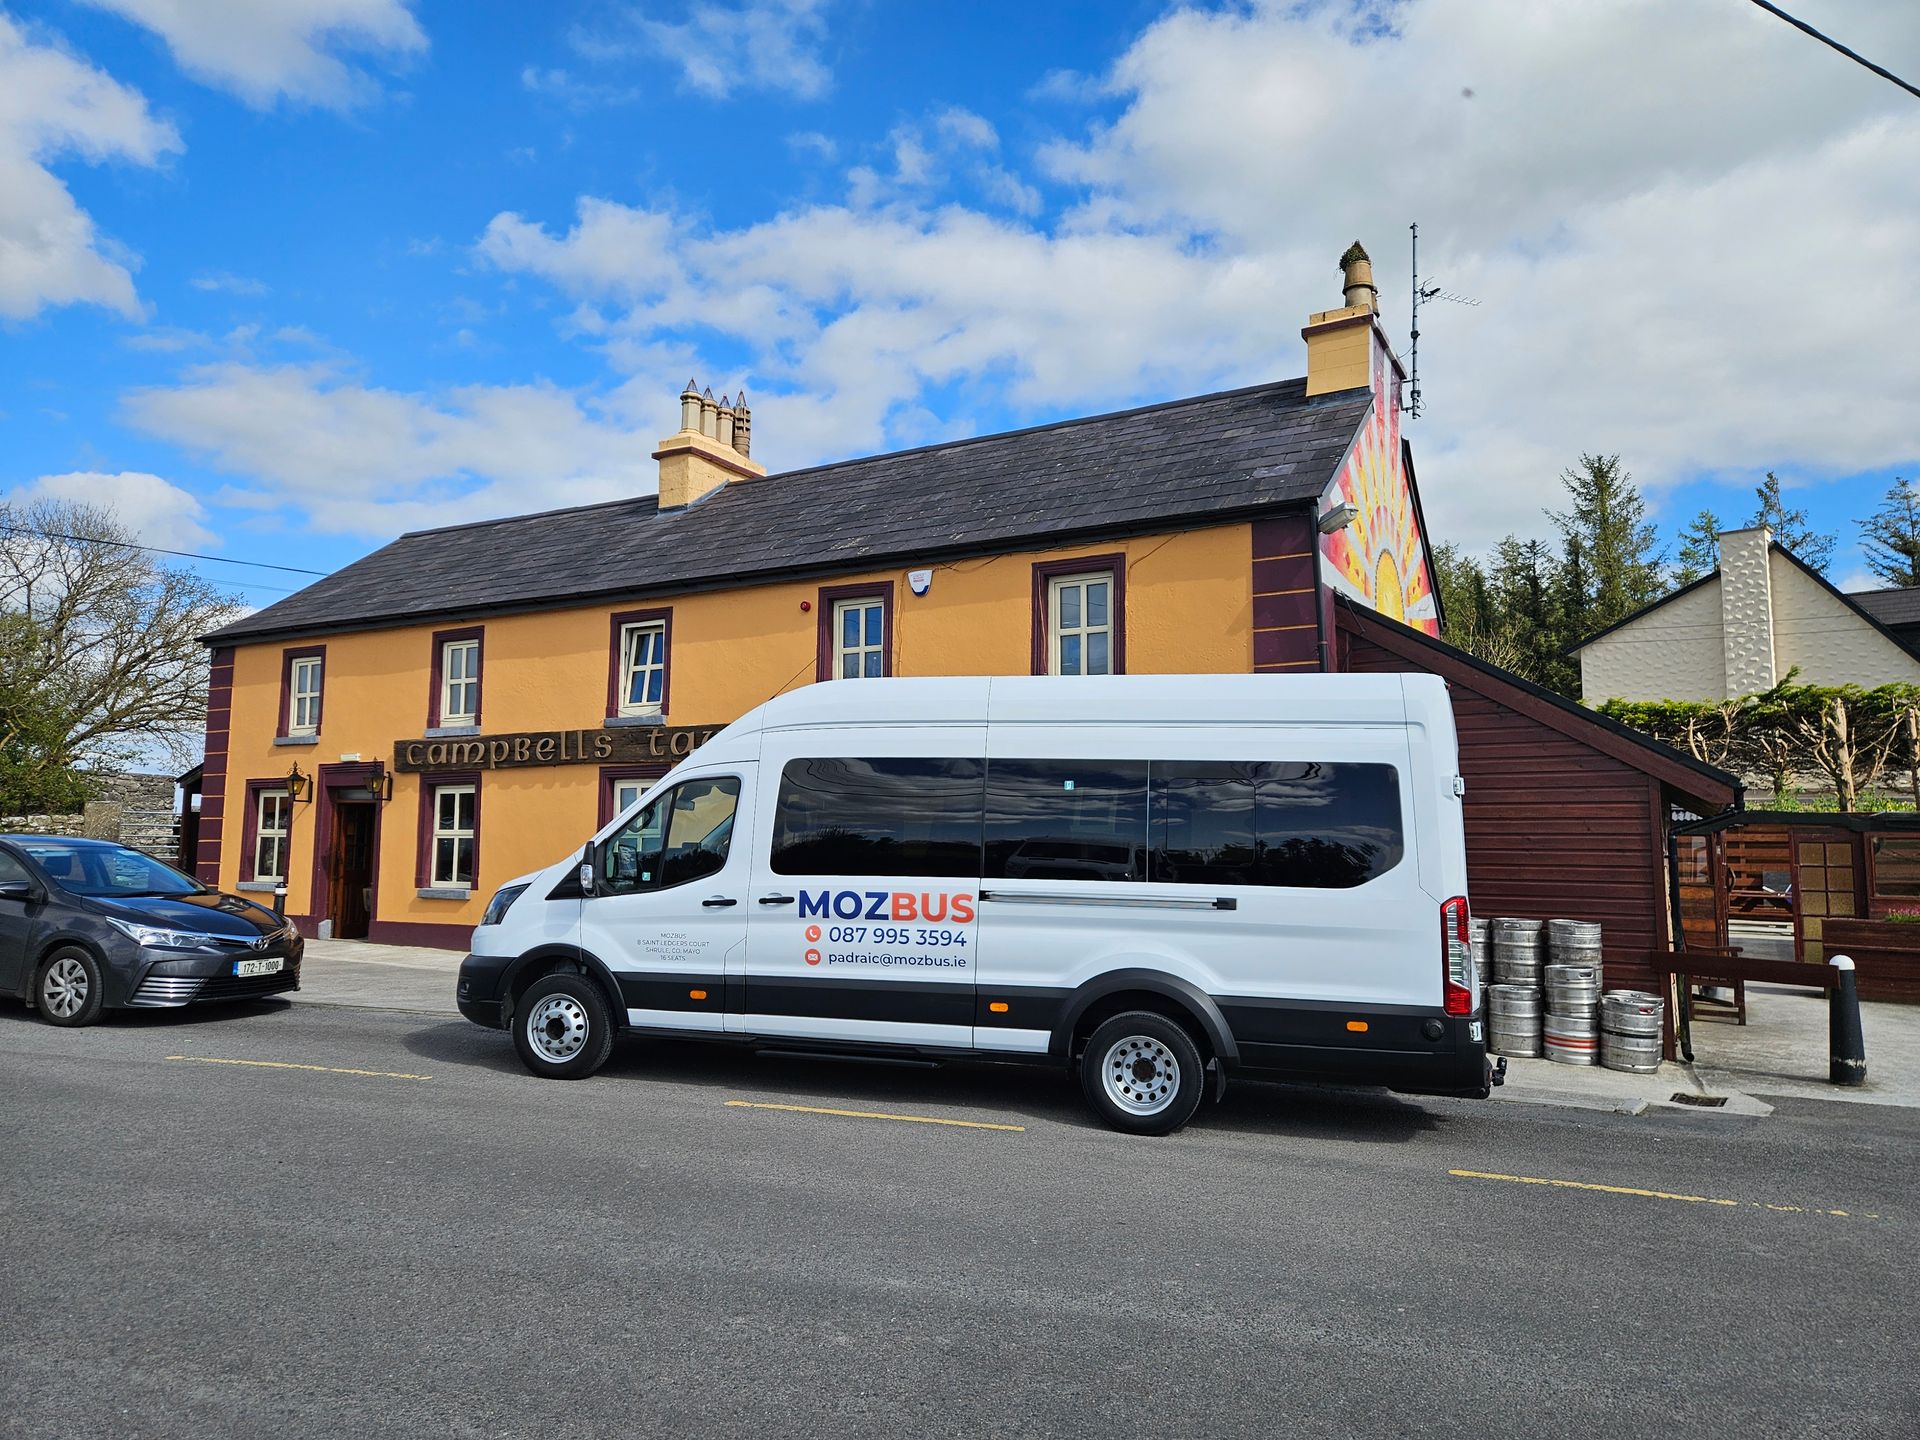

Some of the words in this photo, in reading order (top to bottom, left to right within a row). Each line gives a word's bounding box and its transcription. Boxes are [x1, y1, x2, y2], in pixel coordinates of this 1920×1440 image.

[798, 889, 975, 924] MOZBUS
[828, 926, 867, 944] 087
[872, 927, 910, 945] 995
[915, 929, 967, 947] 3594
[828, 951, 967, 968] padraic@mozbus.ie
